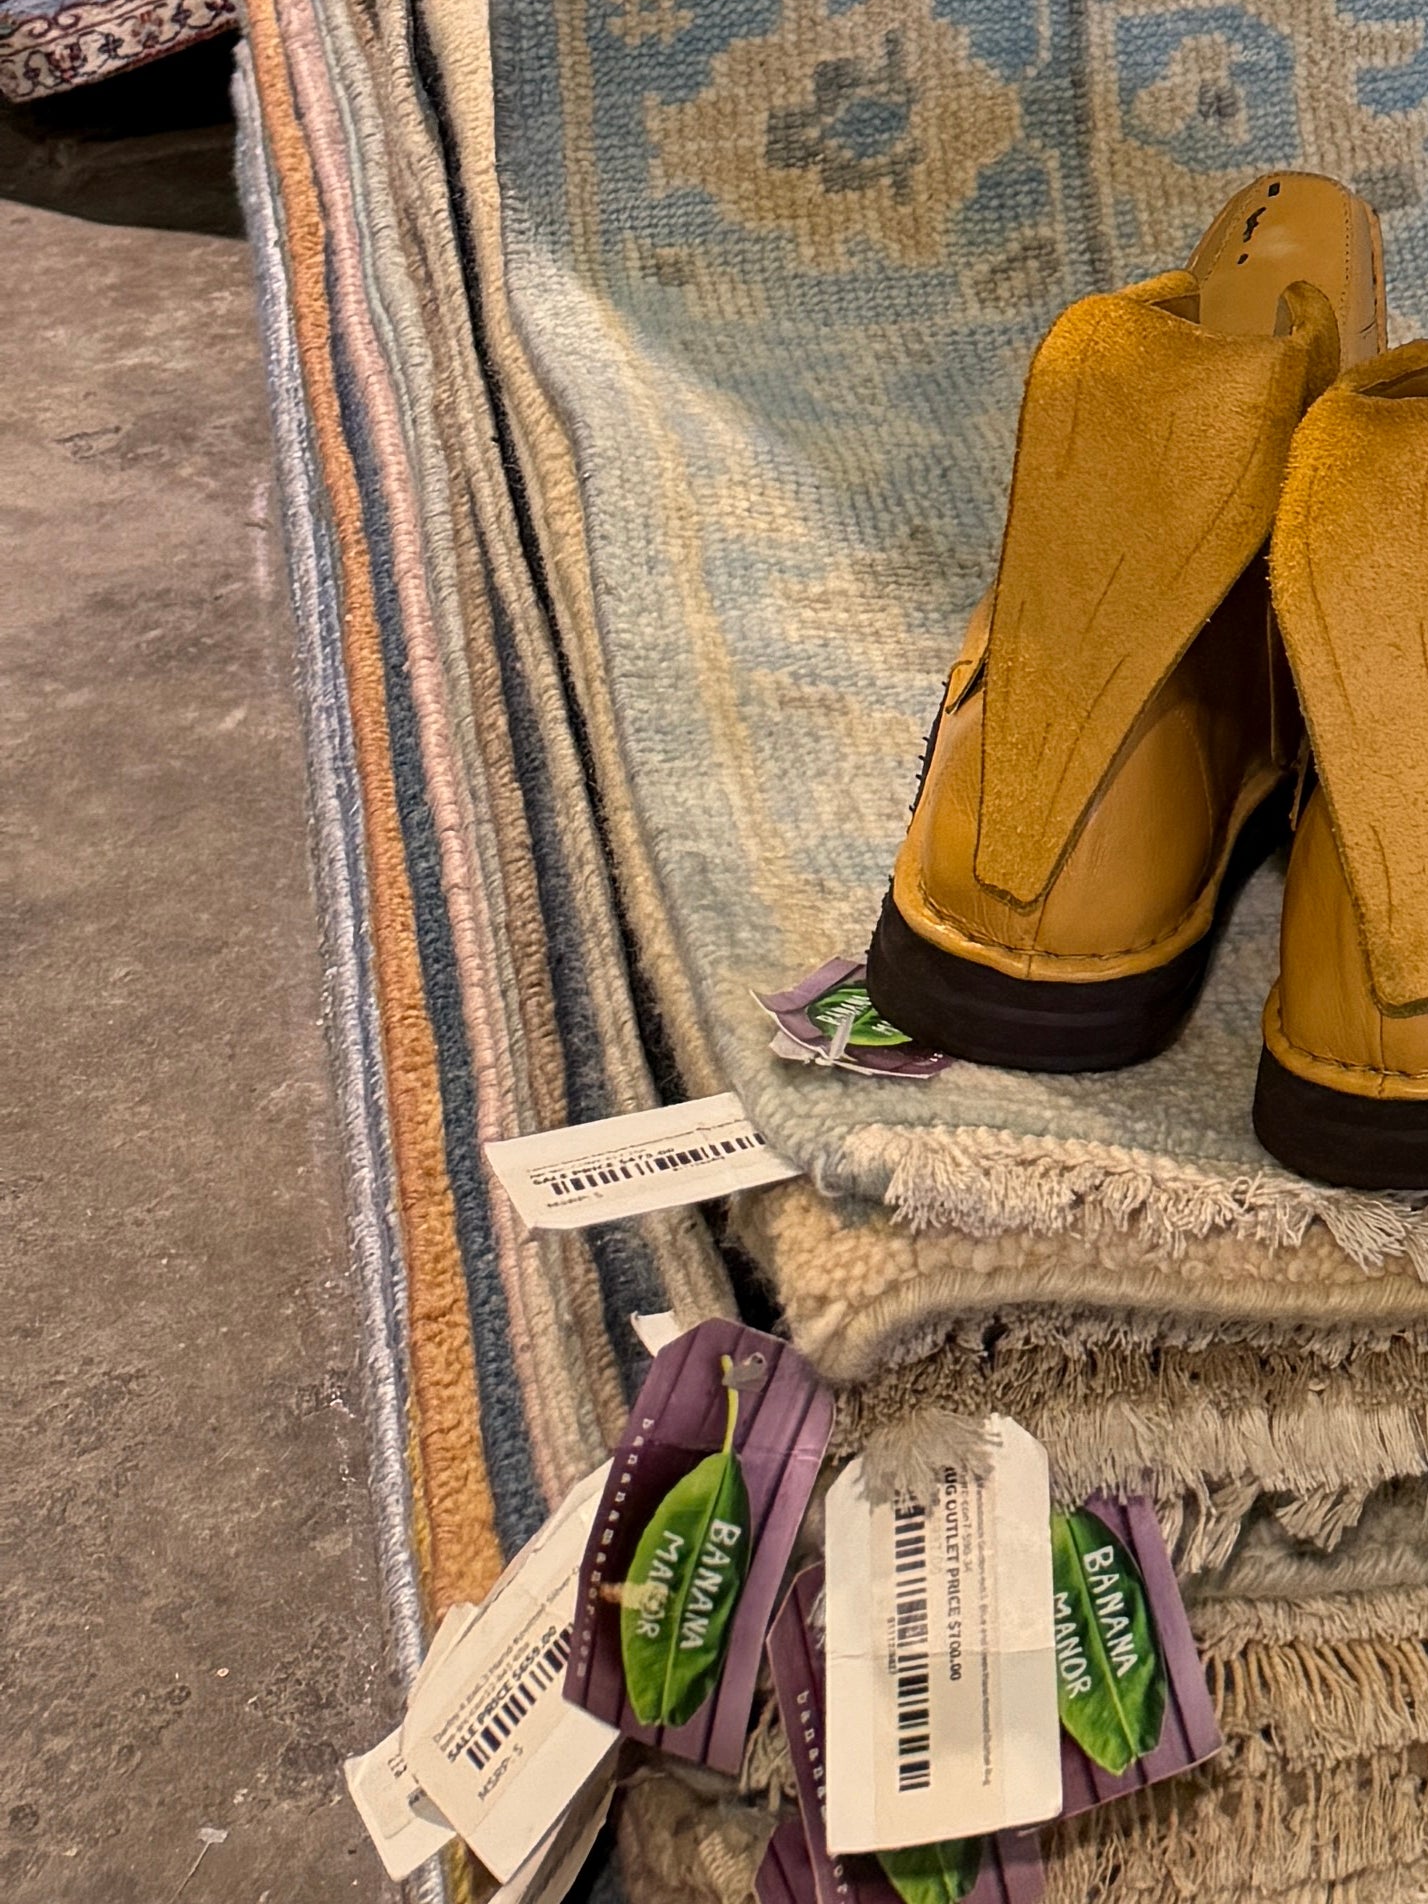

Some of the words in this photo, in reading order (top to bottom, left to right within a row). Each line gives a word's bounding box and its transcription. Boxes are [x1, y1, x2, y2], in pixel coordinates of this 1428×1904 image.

[945, 1499, 960, 1562] OUTLET
[635, 1530, 685, 1639] MAOR
[680, 1518, 742, 1649] BANANA
[946, 1567, 961, 1617] PRICE
[1083, 1545, 1139, 1679] BANANA
[947, 1620, 963, 1682] $700.00
[1053, 1592, 1092, 1700] MANOR
[447, 1723, 478, 1762] SALE
[476, 1679, 514, 1725] PRICE
